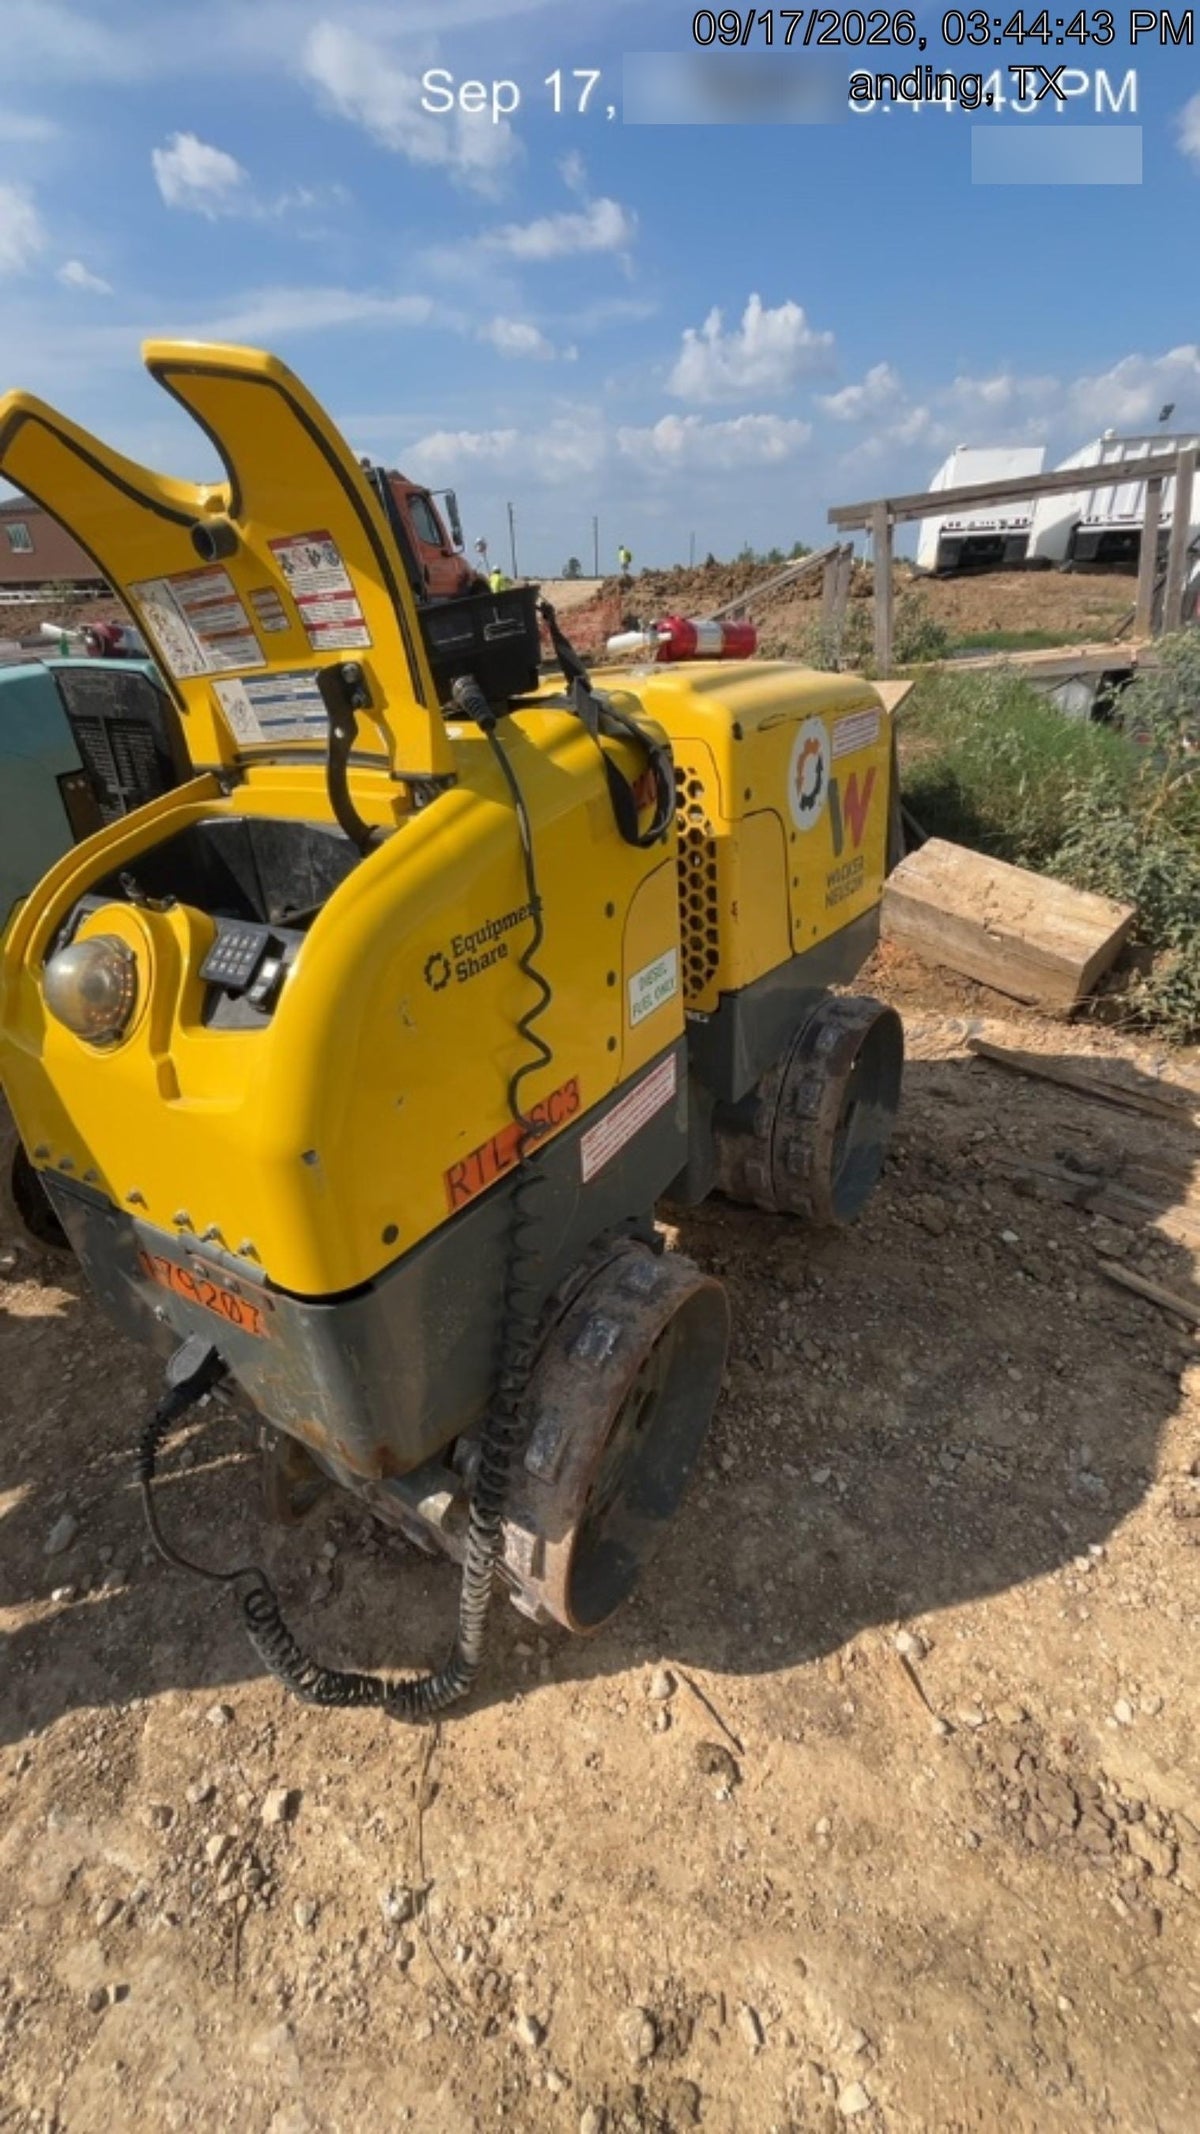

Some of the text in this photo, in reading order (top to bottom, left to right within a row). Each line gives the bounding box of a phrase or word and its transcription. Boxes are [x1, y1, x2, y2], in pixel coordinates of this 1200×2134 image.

[451, 896, 543, 958] Equipmet
[455, 943, 508, 983] Share
[632, 977, 674, 1018] FUEL ONLY
